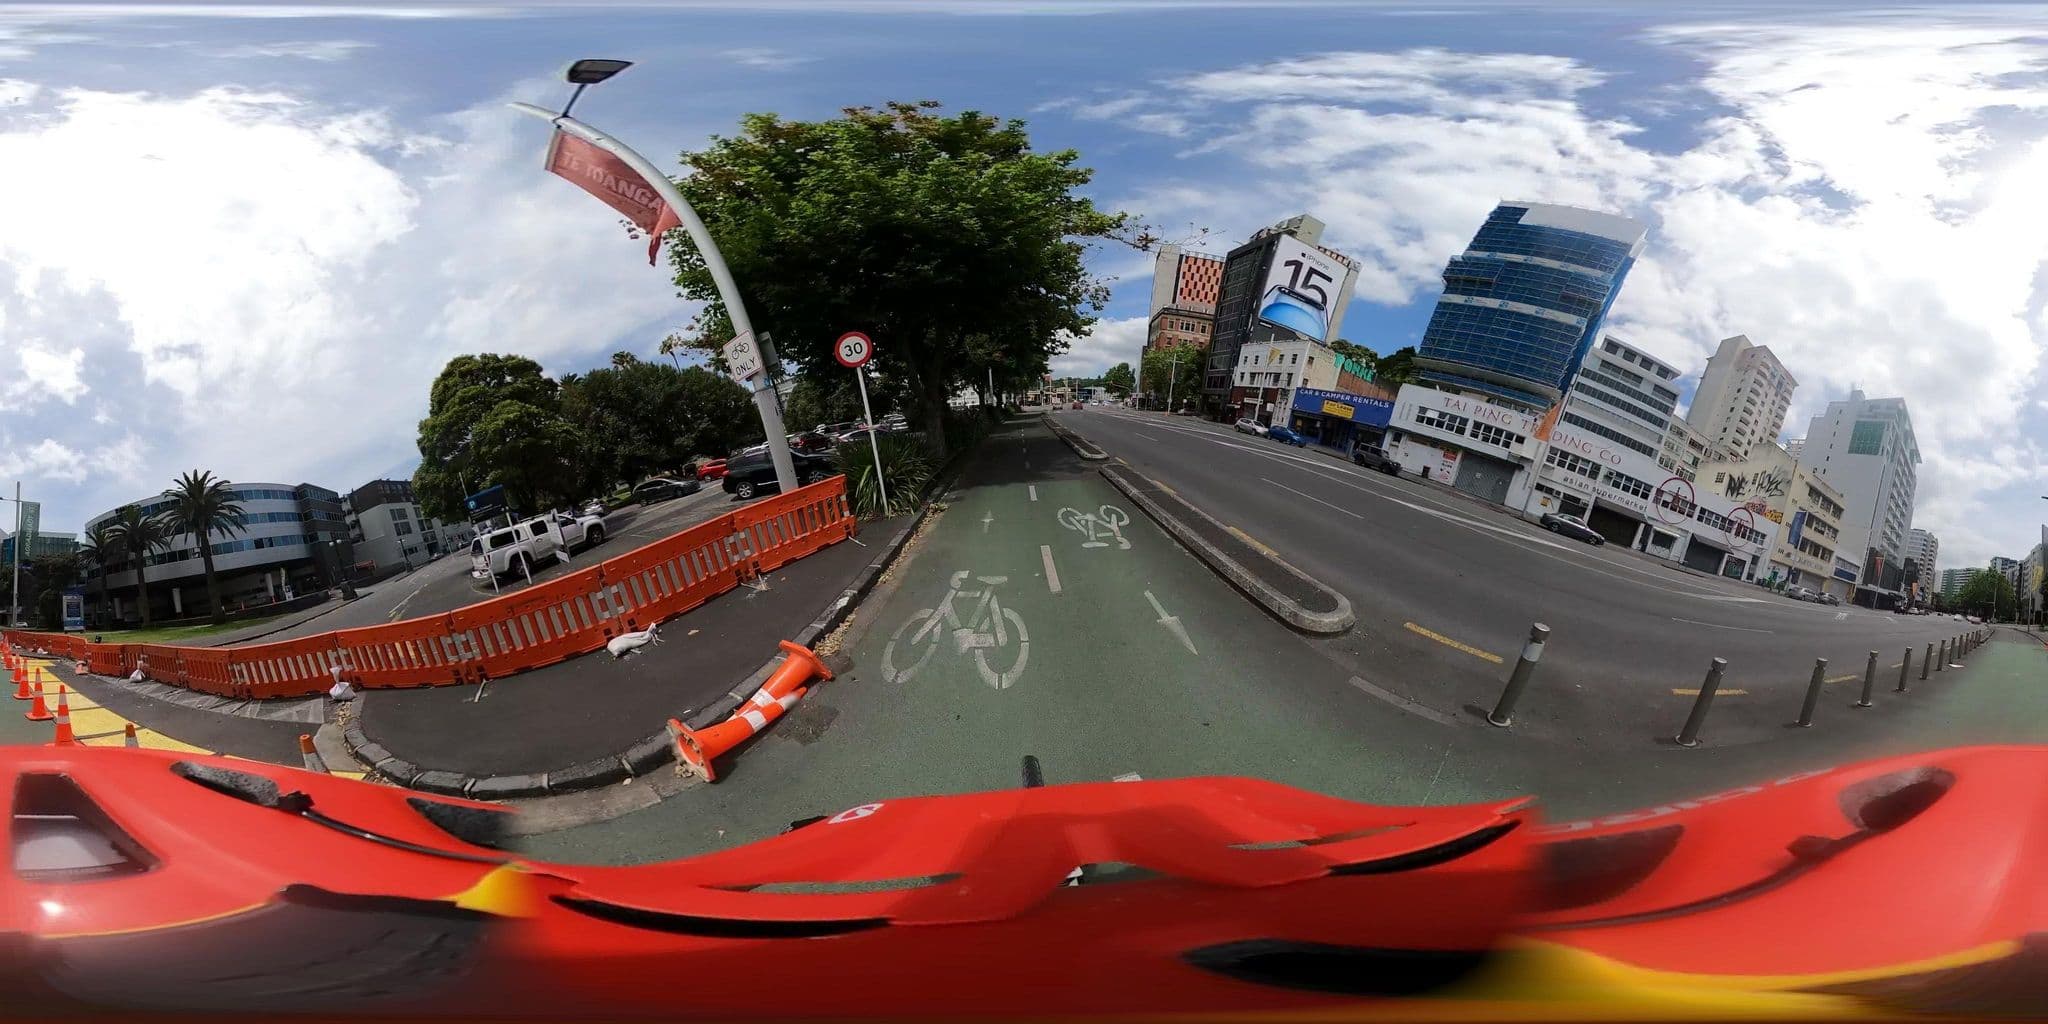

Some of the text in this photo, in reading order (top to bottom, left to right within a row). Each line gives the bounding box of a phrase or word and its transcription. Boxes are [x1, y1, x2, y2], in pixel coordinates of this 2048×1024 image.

[1284, 259, 1333, 306] 15
[844, 342, 863, 357] 30
[735, 357, 756, 376] ONLY
[1300, 387, 1314, 396] CAR
[1321, 391, 1351, 402] CAMPER
[1353, 396, 1389, 409] RENTALS
[1444, 397, 1622, 465] TAI PING TRDING CO
[1563, 476, 1648, 512] asian supermarket
